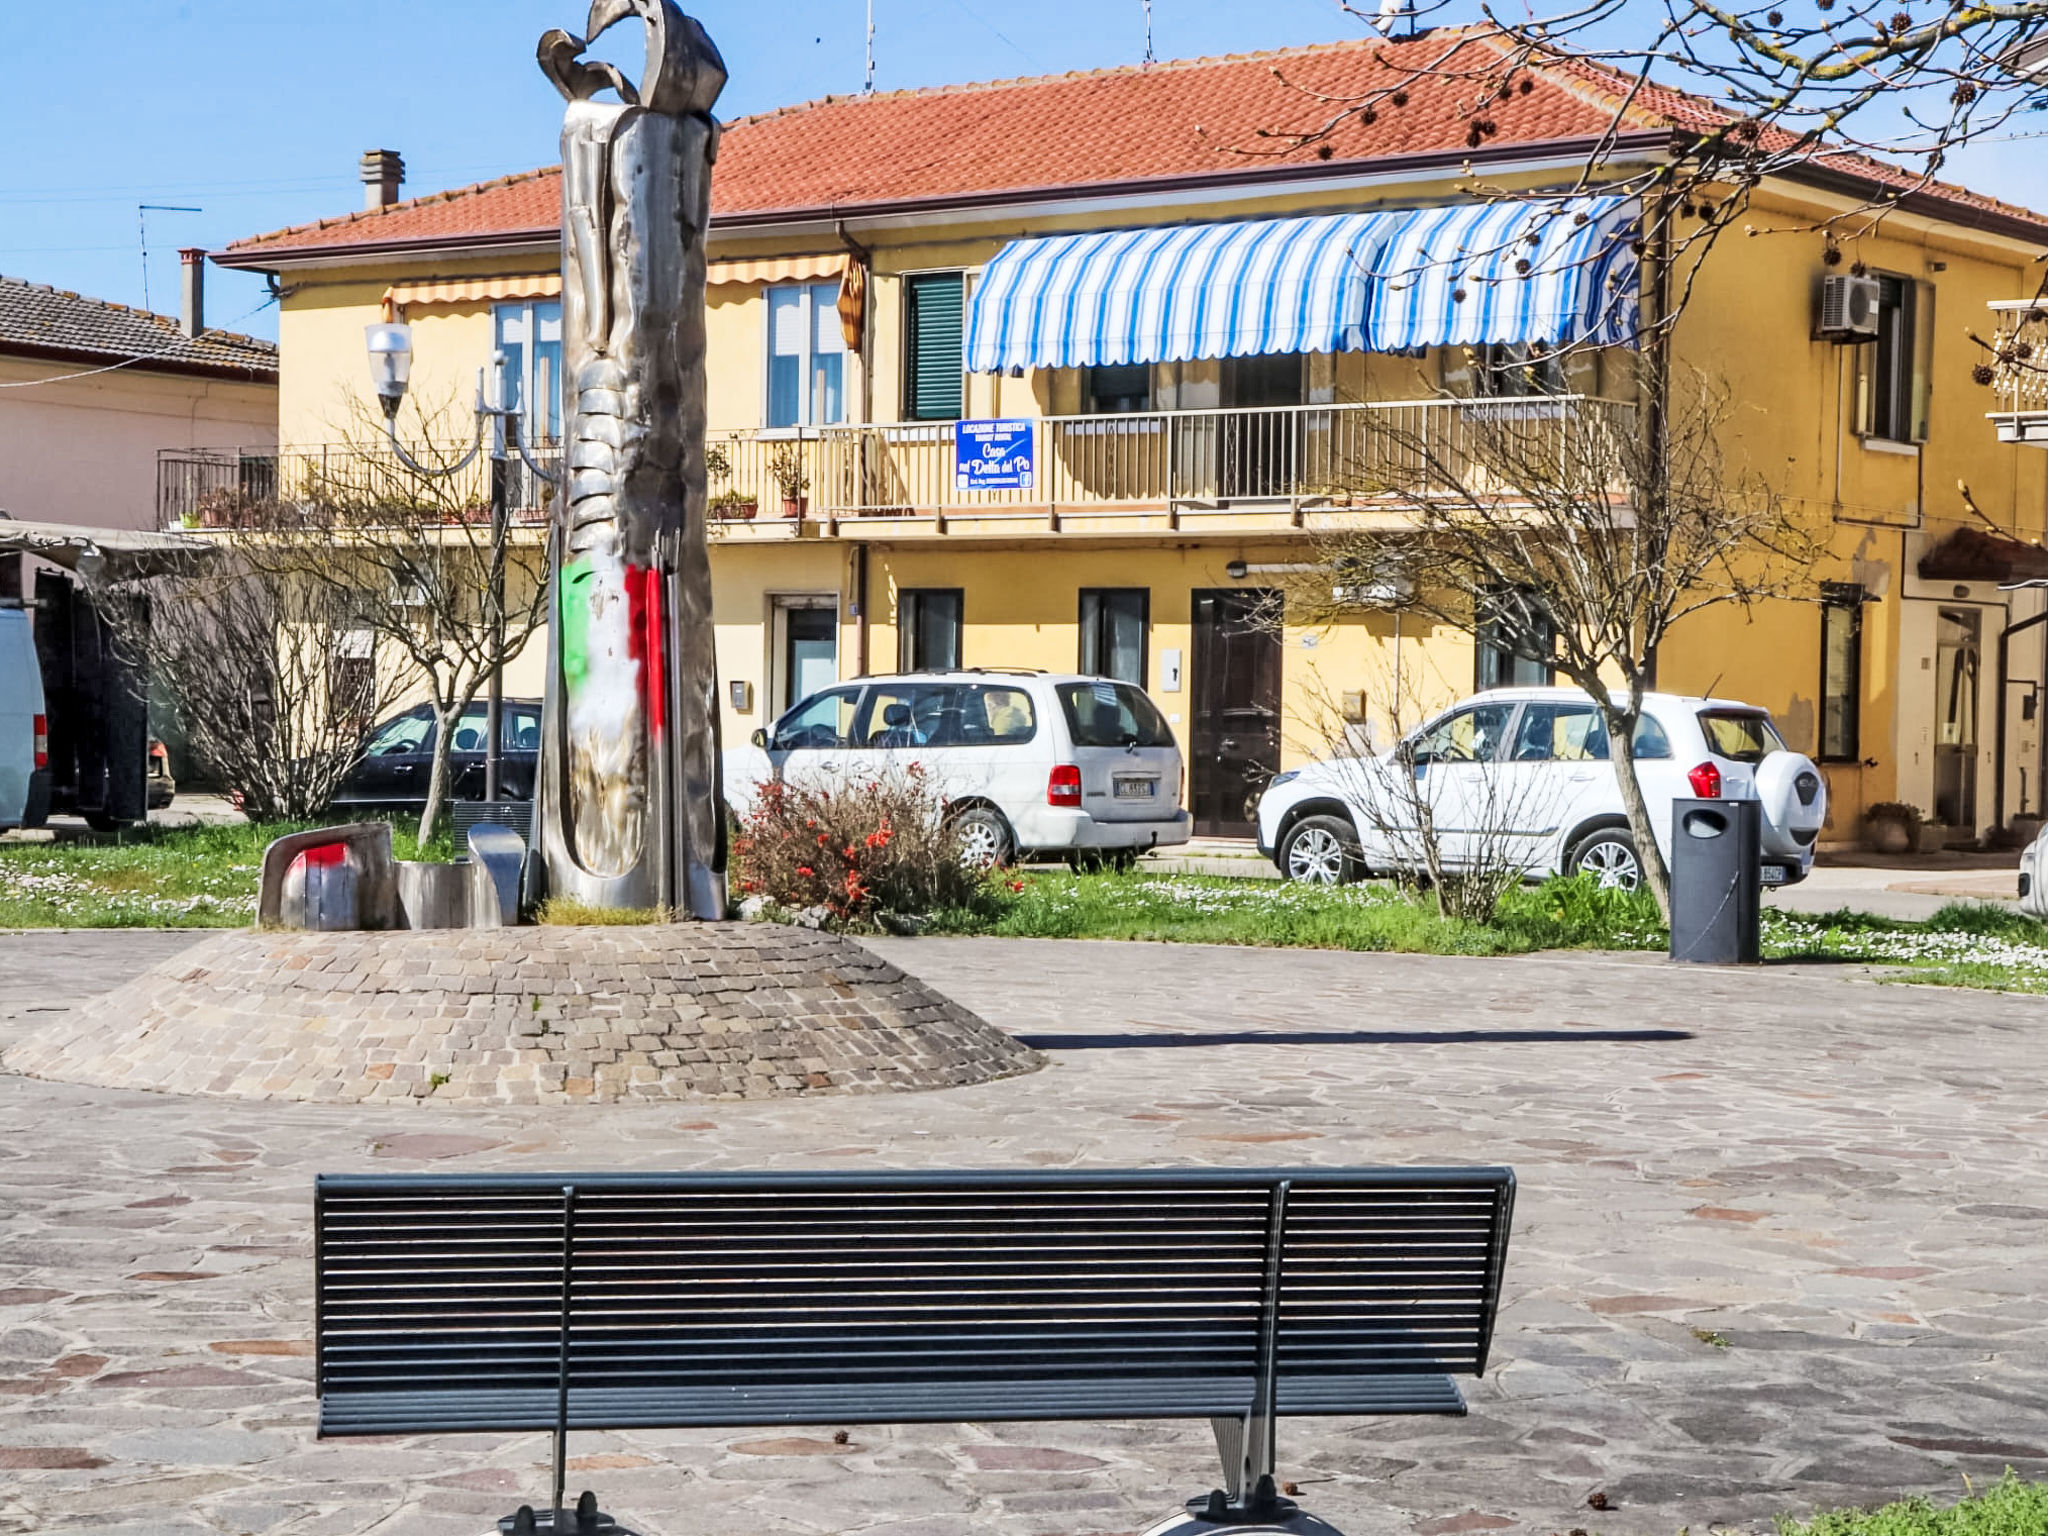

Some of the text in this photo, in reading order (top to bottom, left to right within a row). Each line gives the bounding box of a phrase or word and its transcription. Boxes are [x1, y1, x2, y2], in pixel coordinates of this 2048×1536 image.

[982, 443, 1006, 458] Casa
[971, 459, 1000, 475] Delta
[1001, 460, 1013, 473] del
[1013, 456, 1030, 472] Po
